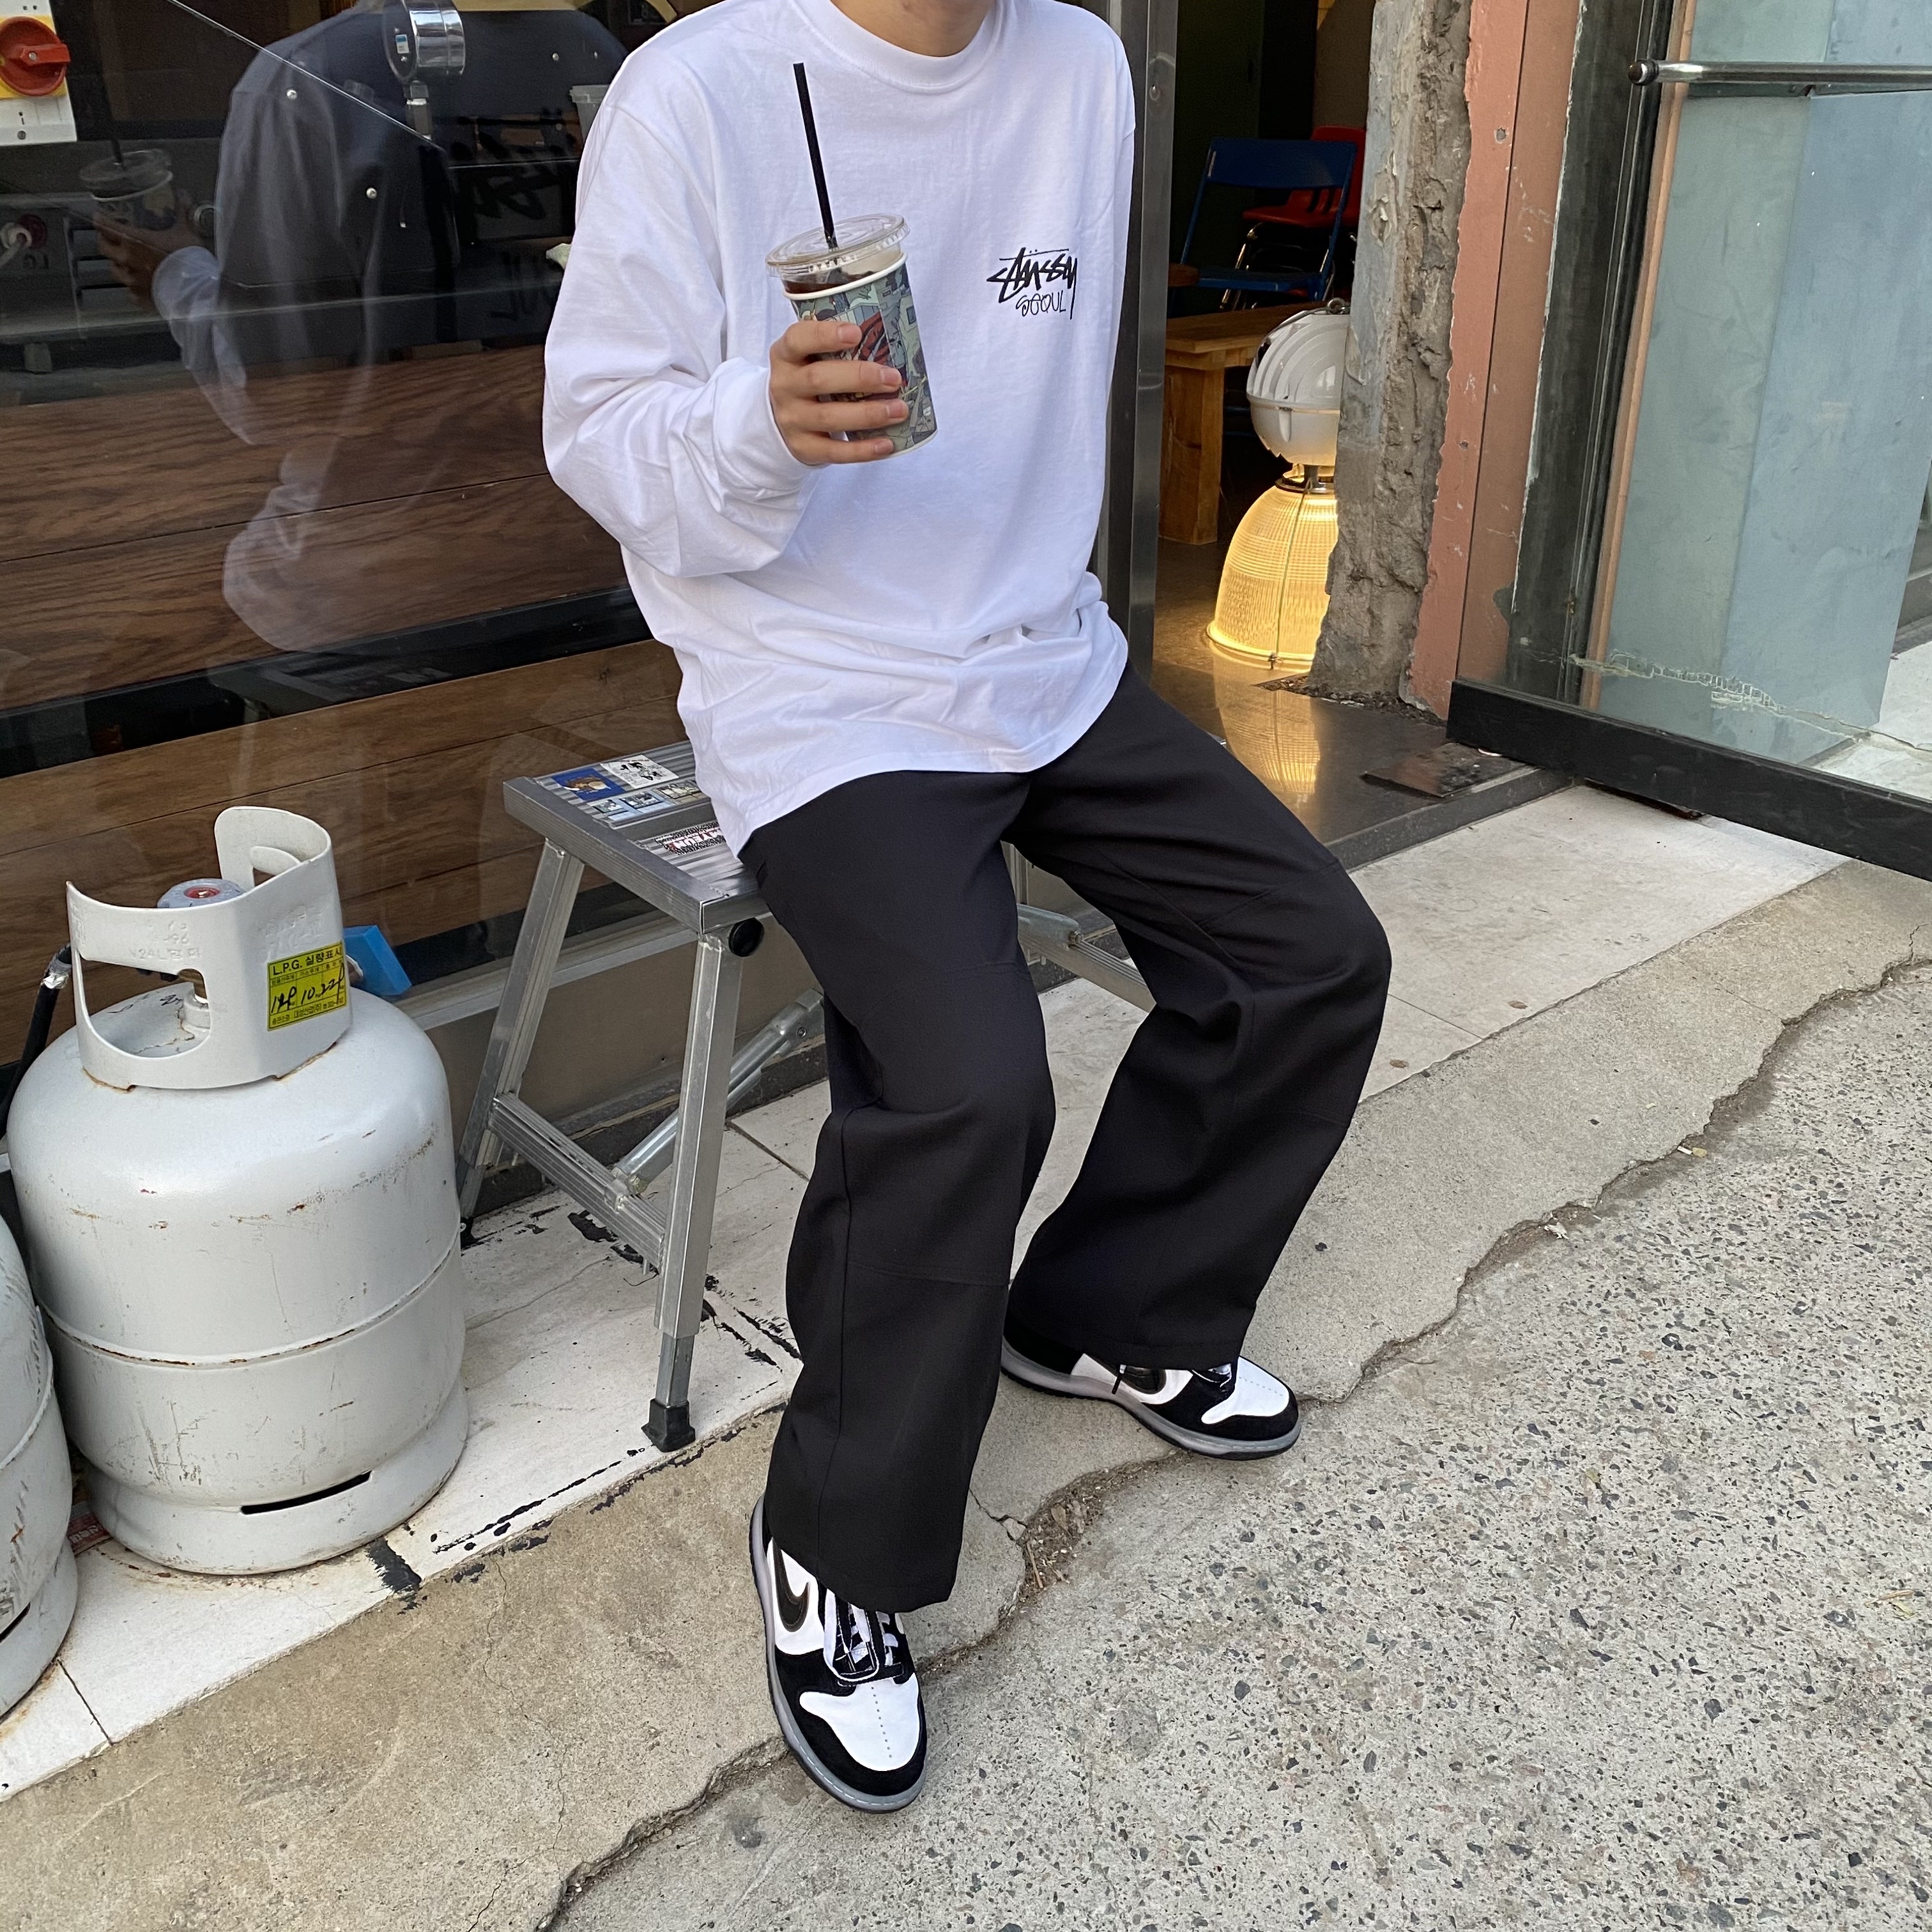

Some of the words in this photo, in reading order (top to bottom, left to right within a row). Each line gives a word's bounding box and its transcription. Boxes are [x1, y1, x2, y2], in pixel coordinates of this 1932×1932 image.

[1016, 290, 1066, 317] SEOUL
[273, 960, 303, 976] L.P.G.
[305, 947, 342, 965] 실량표시
